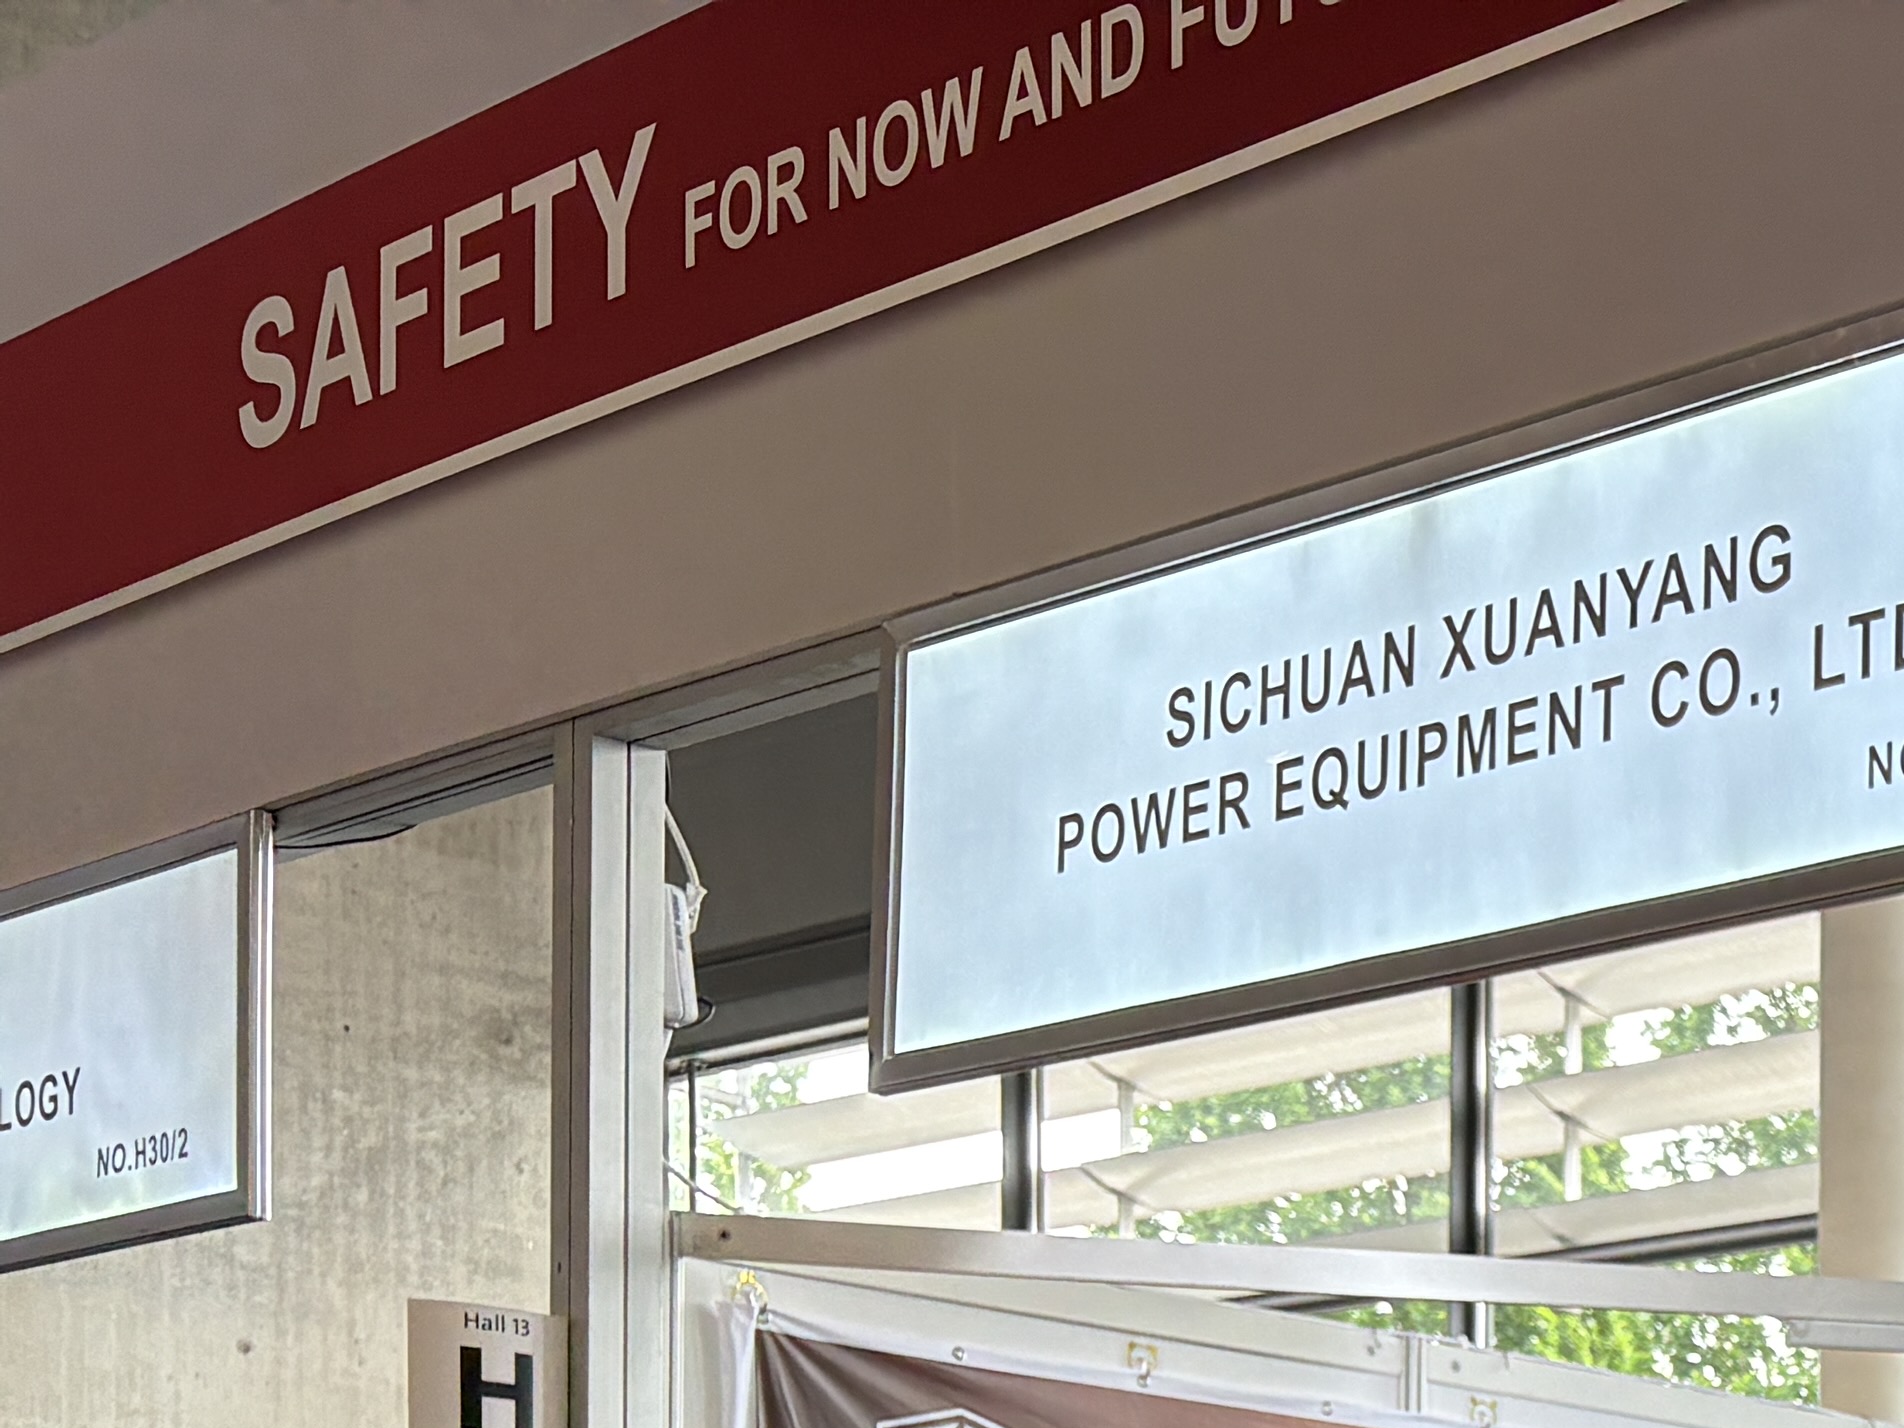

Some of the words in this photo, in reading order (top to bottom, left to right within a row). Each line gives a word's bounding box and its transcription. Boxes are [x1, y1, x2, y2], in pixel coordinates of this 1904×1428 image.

[238, 124, 659, 449] SAFETY
[683, 143, 809, 268] FOR
[827, 67, 983, 211] NOW
[998, 0, 1144, 141] AND
[1166, 624, 1418, 748] SICHUAN
[1440, 523, 1794, 678] XUANYANG
[1055, 767, 1252, 874] POWER
[1273, 678, 1626, 821] EQUIPMENT
[1648, 646, 1782, 727] CO.,
[97, 1128, 188, 1178] NO.H30/2
[463, 1310, 505, 1334] Hall
[512, 1317, 530, 1338] 13
